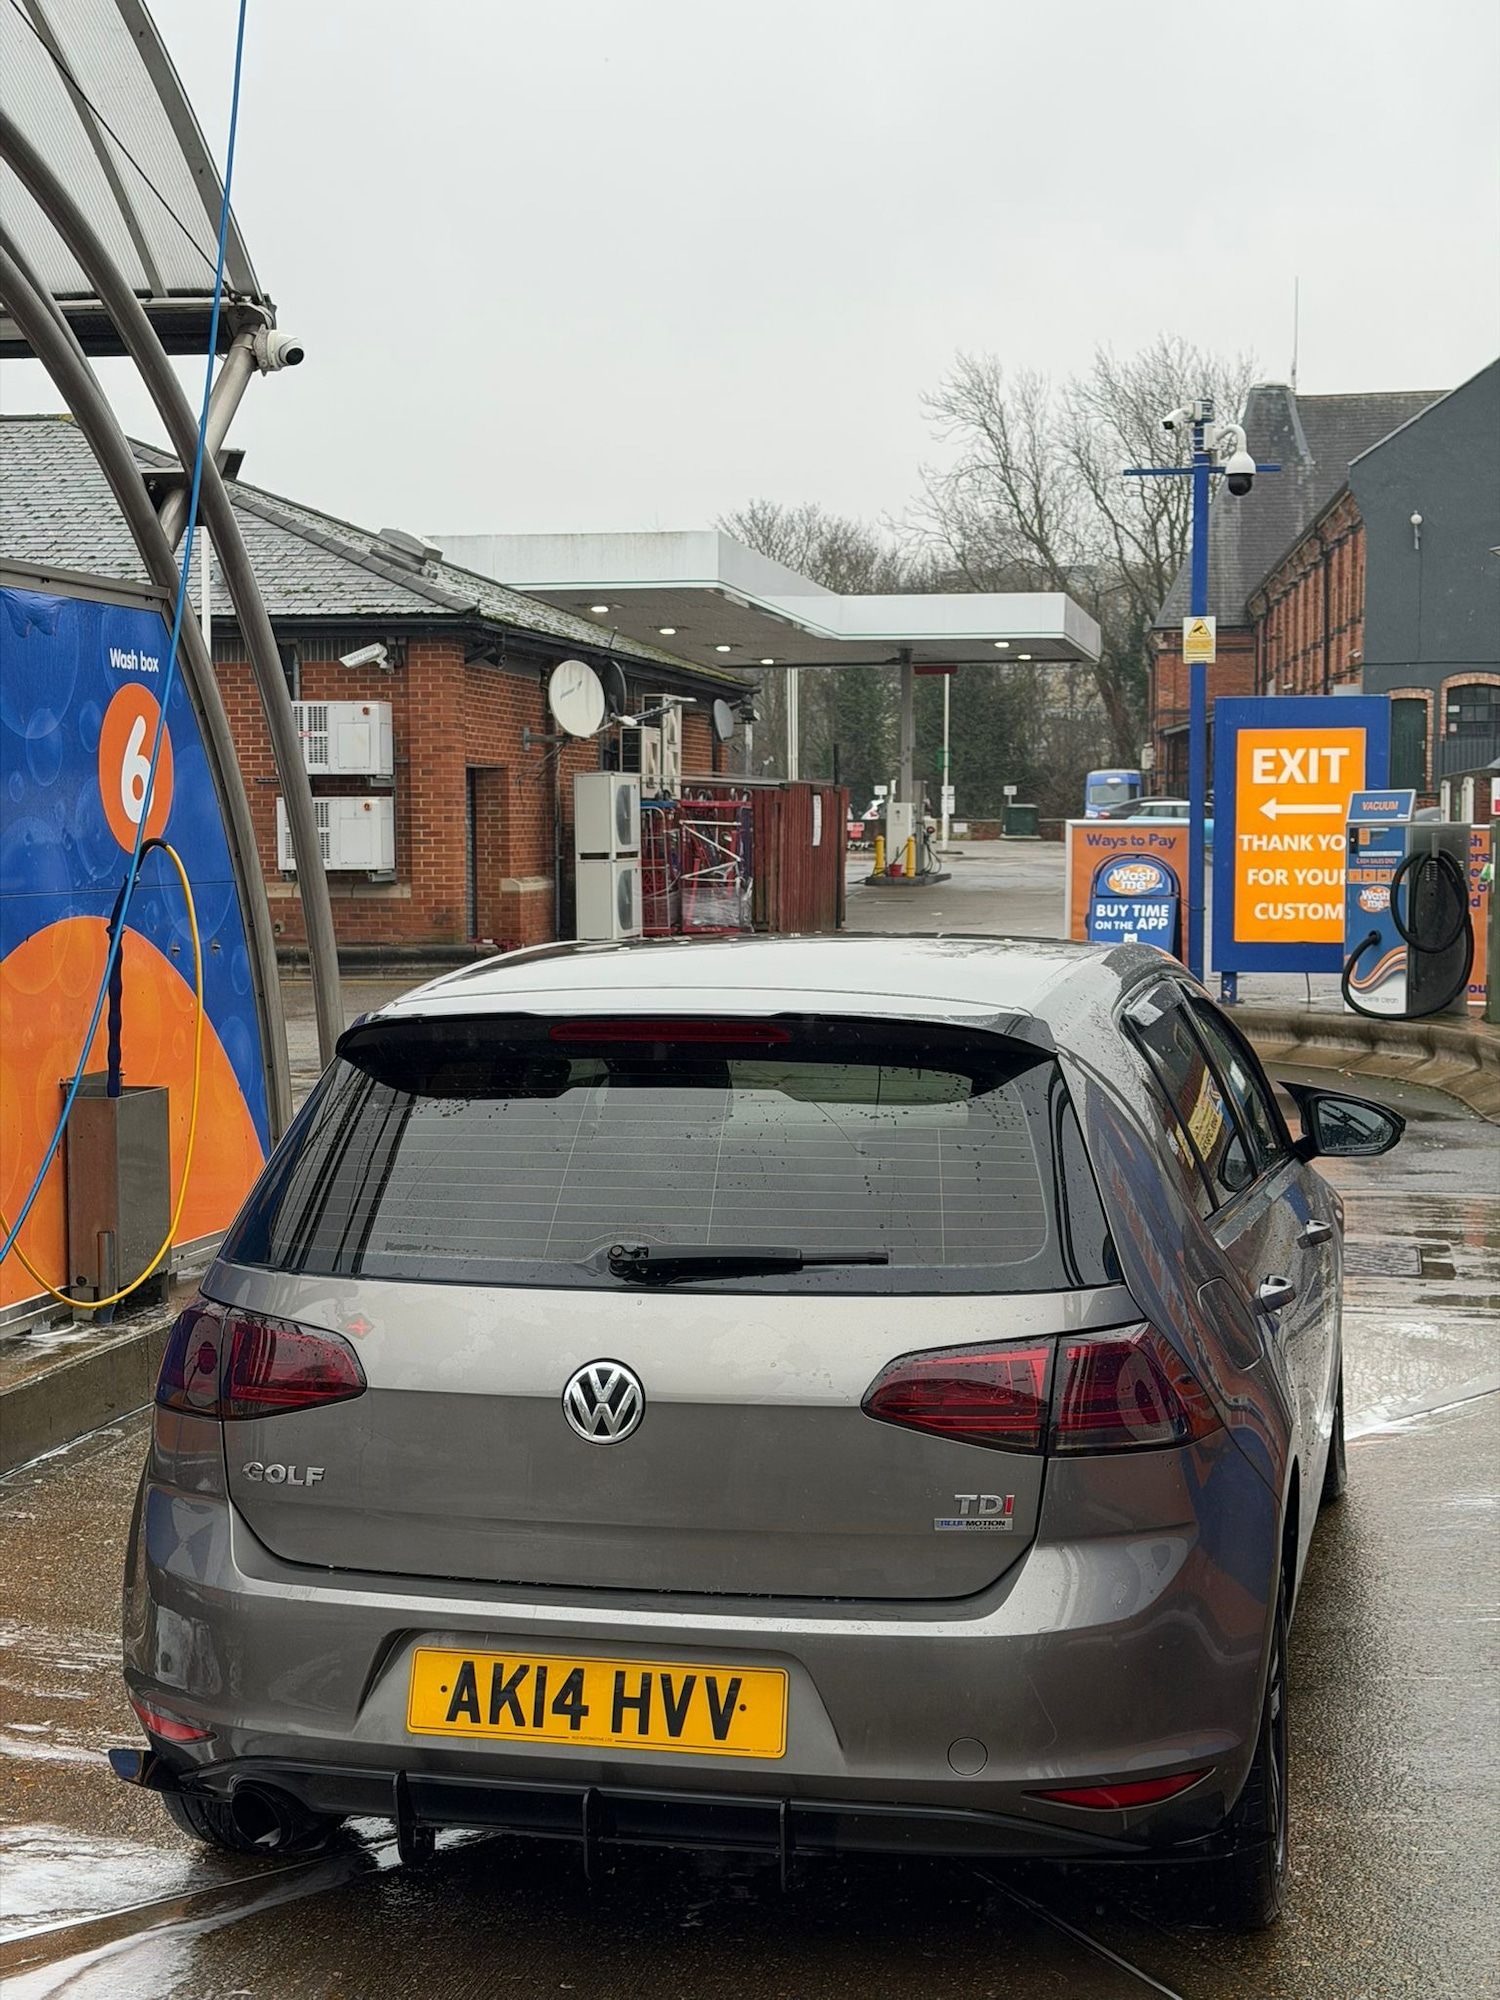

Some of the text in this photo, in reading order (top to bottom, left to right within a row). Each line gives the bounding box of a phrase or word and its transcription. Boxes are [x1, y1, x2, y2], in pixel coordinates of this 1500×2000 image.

[109, 647, 159, 673] Wash box
[121, 715, 155, 825] 6
[1252, 747, 1350, 784] EXIT
[1362, 801, 1399, 811] VACUUM
[1086, 833, 1176, 849] Ways to Pay
[1239, 834, 1315, 851] THANK
[1113, 869, 1156, 881] Wash
[1247, 868, 1289, 886] FOR
[1121, 880, 1146, 889] me
[1361, 889, 1391, 901] Wash
[1096, 904, 1170, 917] BUY TIME
[1367, 900, 1384, 909] me
[1095, 918, 1168, 930] ON THE APP
[242, 1461, 325, 1487] GOLF
[954, 1494, 1015, 1515] TDI
[446, 1660, 743, 1741] AK14 HVV
